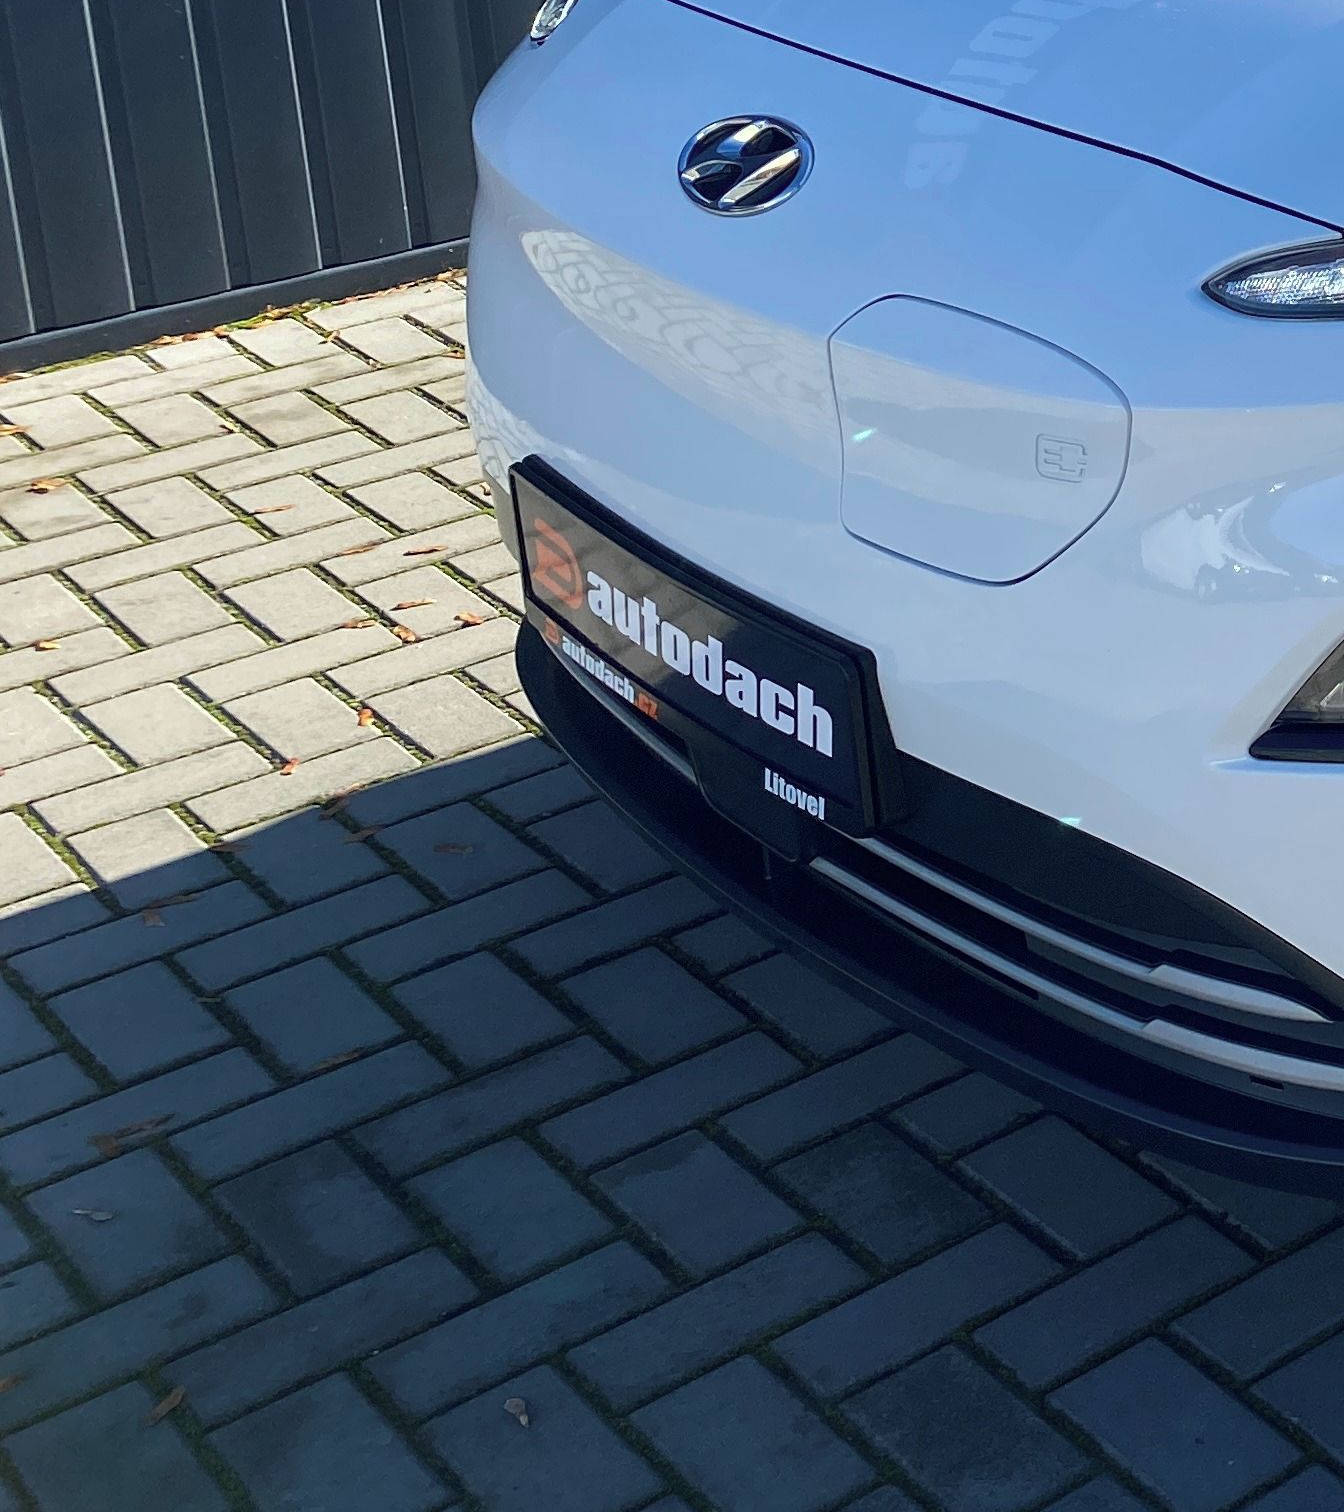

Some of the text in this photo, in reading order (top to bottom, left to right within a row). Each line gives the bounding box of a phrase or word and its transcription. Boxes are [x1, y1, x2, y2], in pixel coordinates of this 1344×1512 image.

[562, 635, 658, 721] autodach.cz
[586, 570, 833, 758] autodach
[763, 766, 826, 821] Litovel
